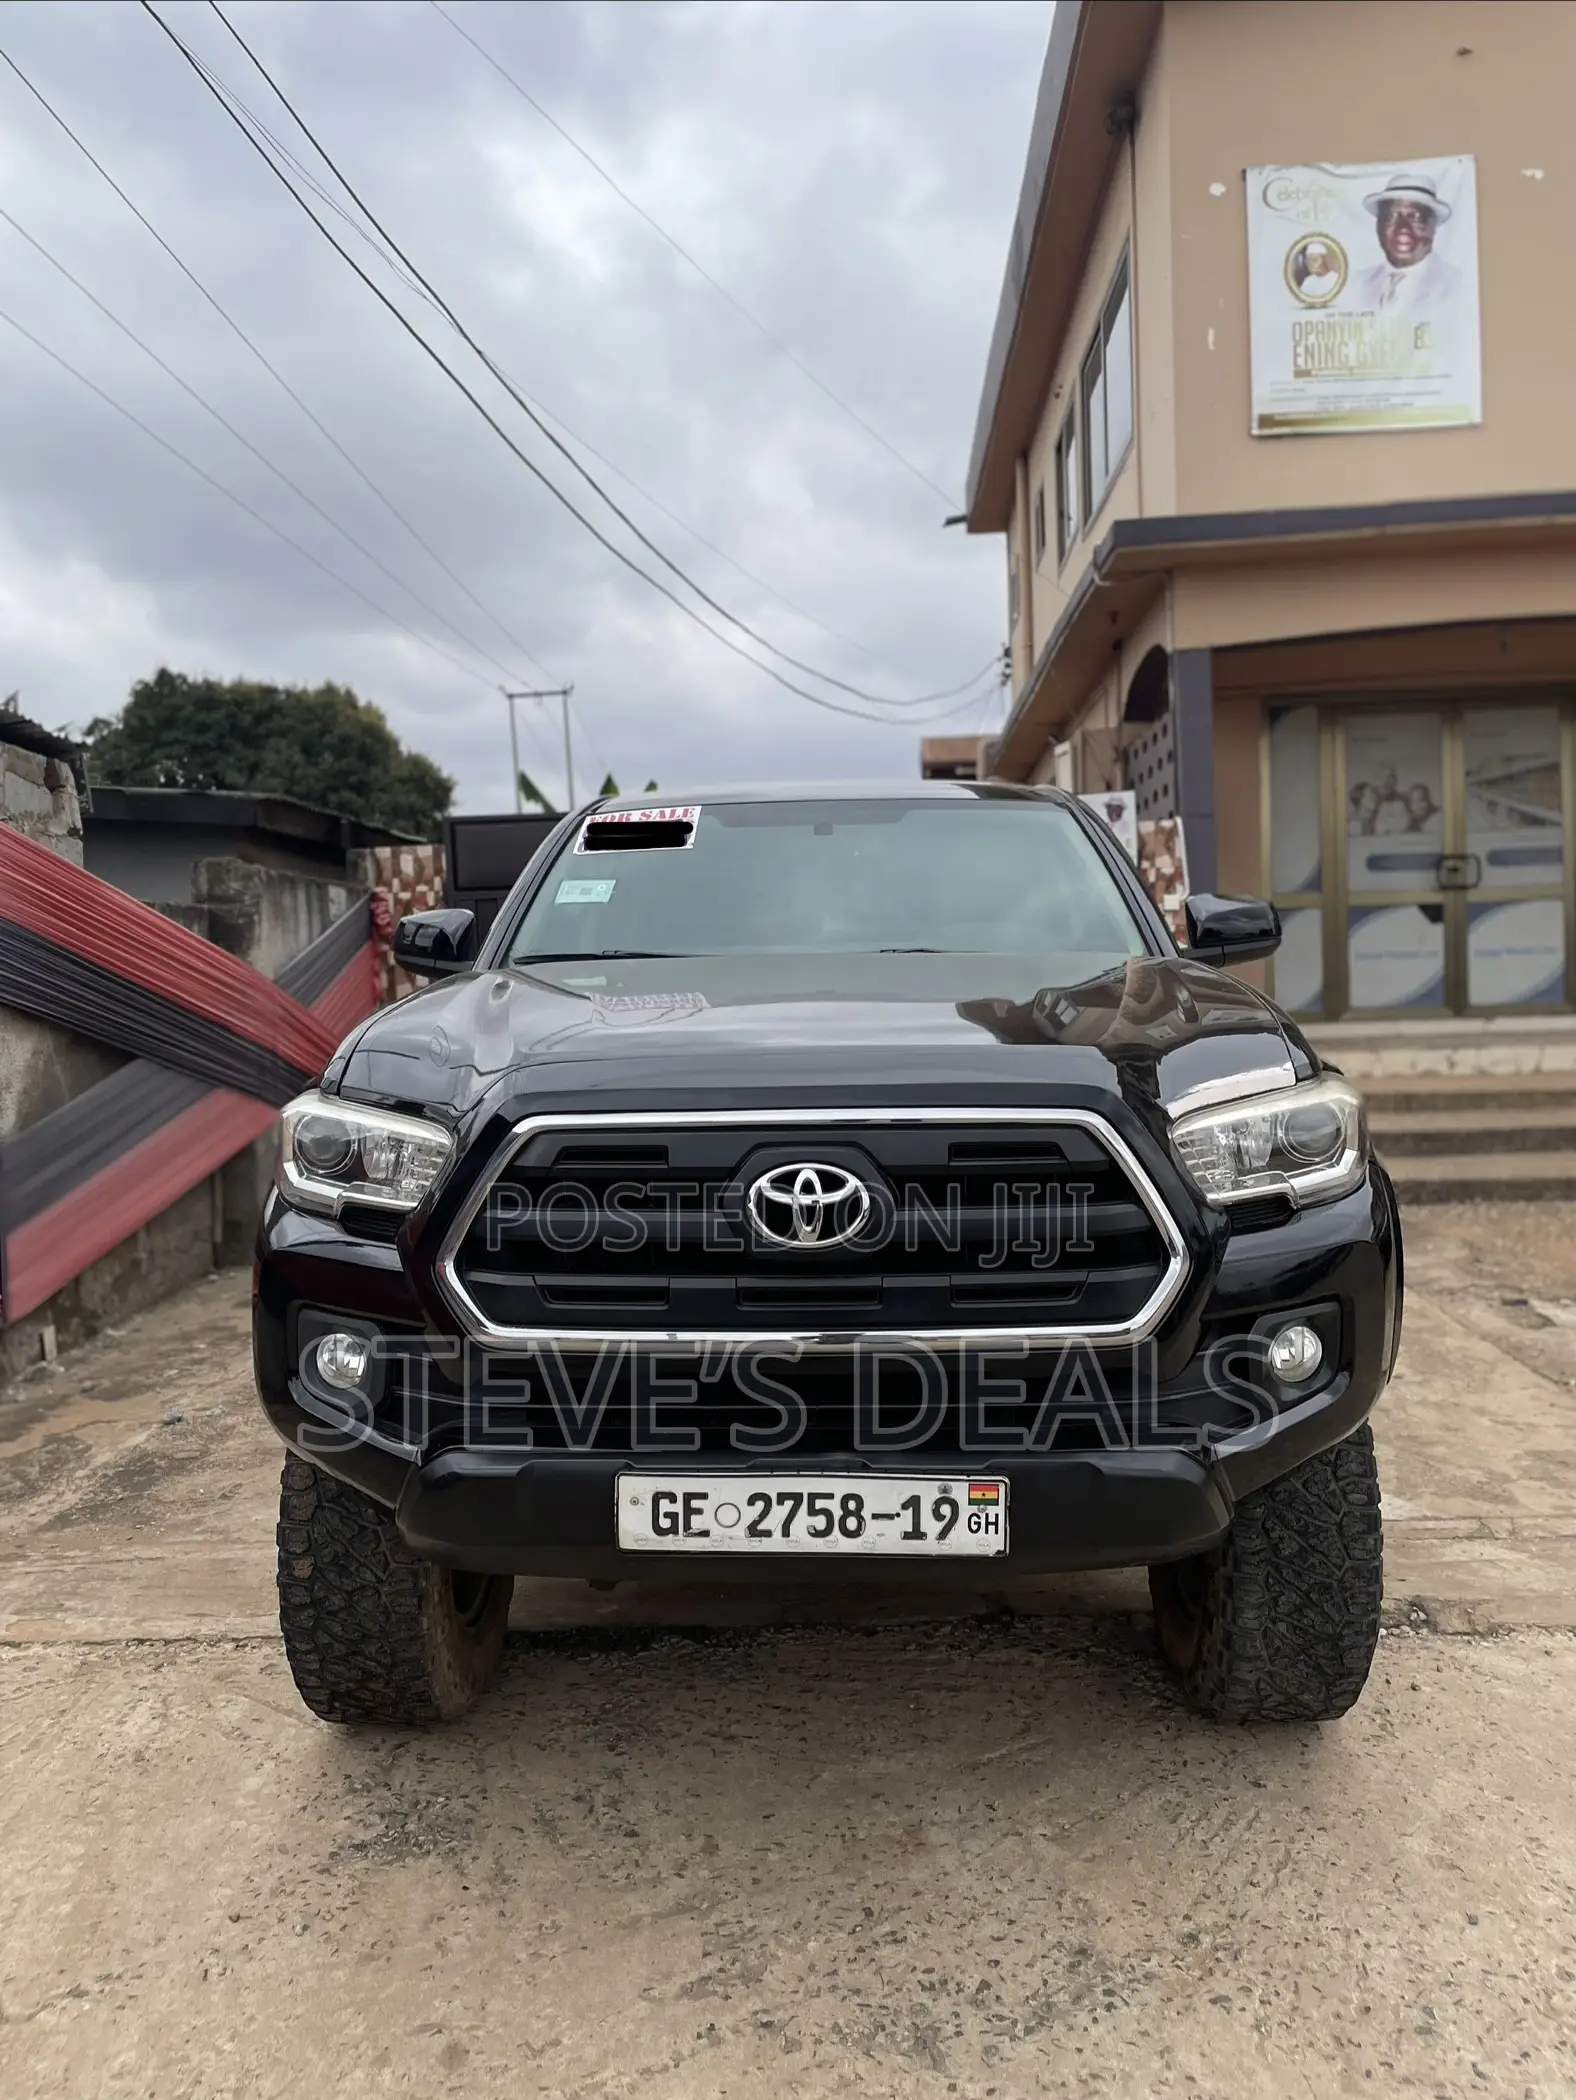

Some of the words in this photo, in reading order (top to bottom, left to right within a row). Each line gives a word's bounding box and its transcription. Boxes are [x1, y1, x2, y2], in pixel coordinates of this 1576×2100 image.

[639, 807, 696, 822] SALE
[651, 1491, 711, 1537] GE
[744, 1491, 960, 1541] 2758-19
[967, 1512, 999, 1535] GH
